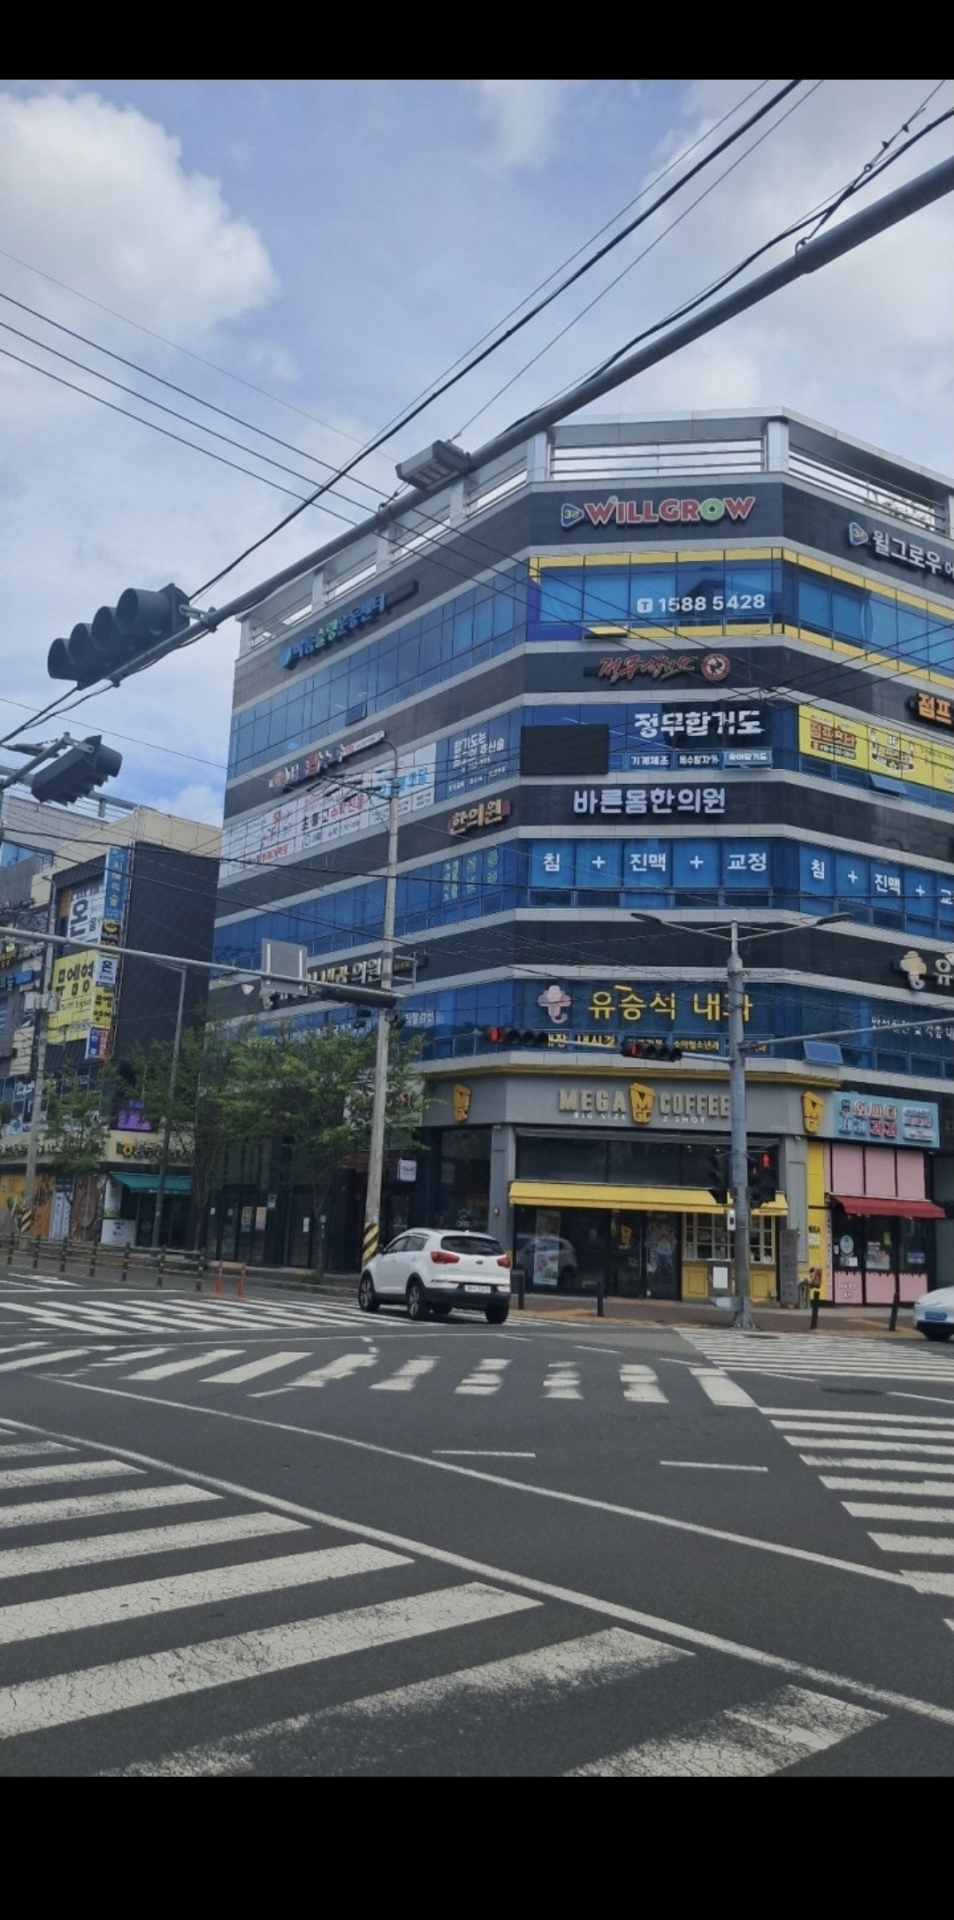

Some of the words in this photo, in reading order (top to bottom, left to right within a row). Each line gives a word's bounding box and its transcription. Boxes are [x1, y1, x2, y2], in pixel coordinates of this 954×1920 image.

[584, 496, 756, 526] WILLGROW
[872, 530, 942, 575] 윌그로우
[658, 596, 707, 613] 1588
[712, 593, 766, 611] 5428
[572, 787, 726, 815] 바른몸한의원
[449, 799, 503, 835] 한의원
[543, 853, 560, 872] 침
[629, 852, 667, 872] 진맥
[727, 852, 767, 872] 교정
[811, 859, 825, 880] 침
[874, 873, 901, 896] 진맥
[588, 990, 676, 1021] 유승석
[558, 1089, 627, 1113] MEGA
[659, 1092, 731, 1117] COFFEE
[573, 1112, 594, 1120] BIG
[600, 1113, 627, 1121] SIZE
[674, 1115, 706, 1124] SHOT
